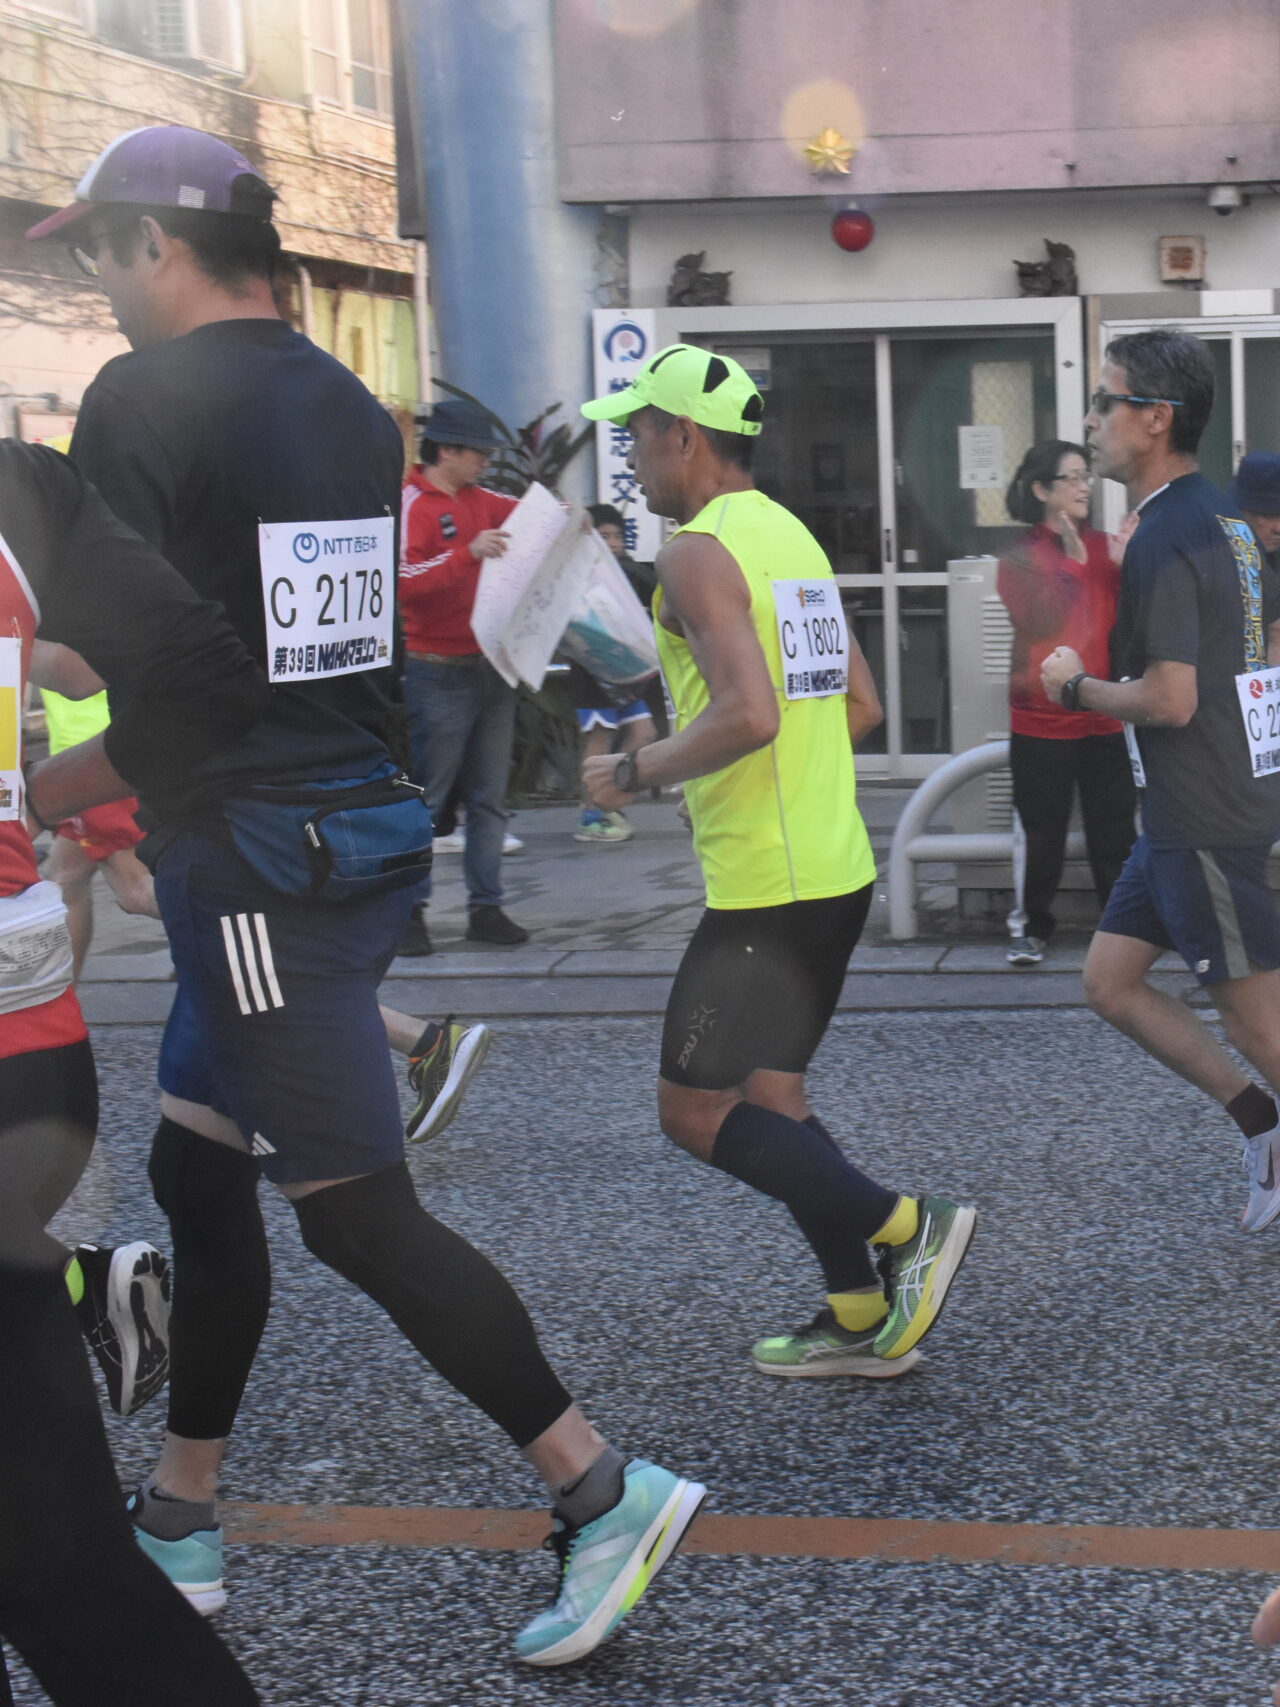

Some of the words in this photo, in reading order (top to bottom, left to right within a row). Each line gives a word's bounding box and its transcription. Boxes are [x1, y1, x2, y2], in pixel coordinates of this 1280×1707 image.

[323, 534, 377, 555] NTT西日本
[270, 576, 297, 629] C
[315, 568, 383, 626] 2178
[782, 619, 797, 659] C
[803, 616, 844, 657] 1802
[1247, 708, 1262, 742] C
